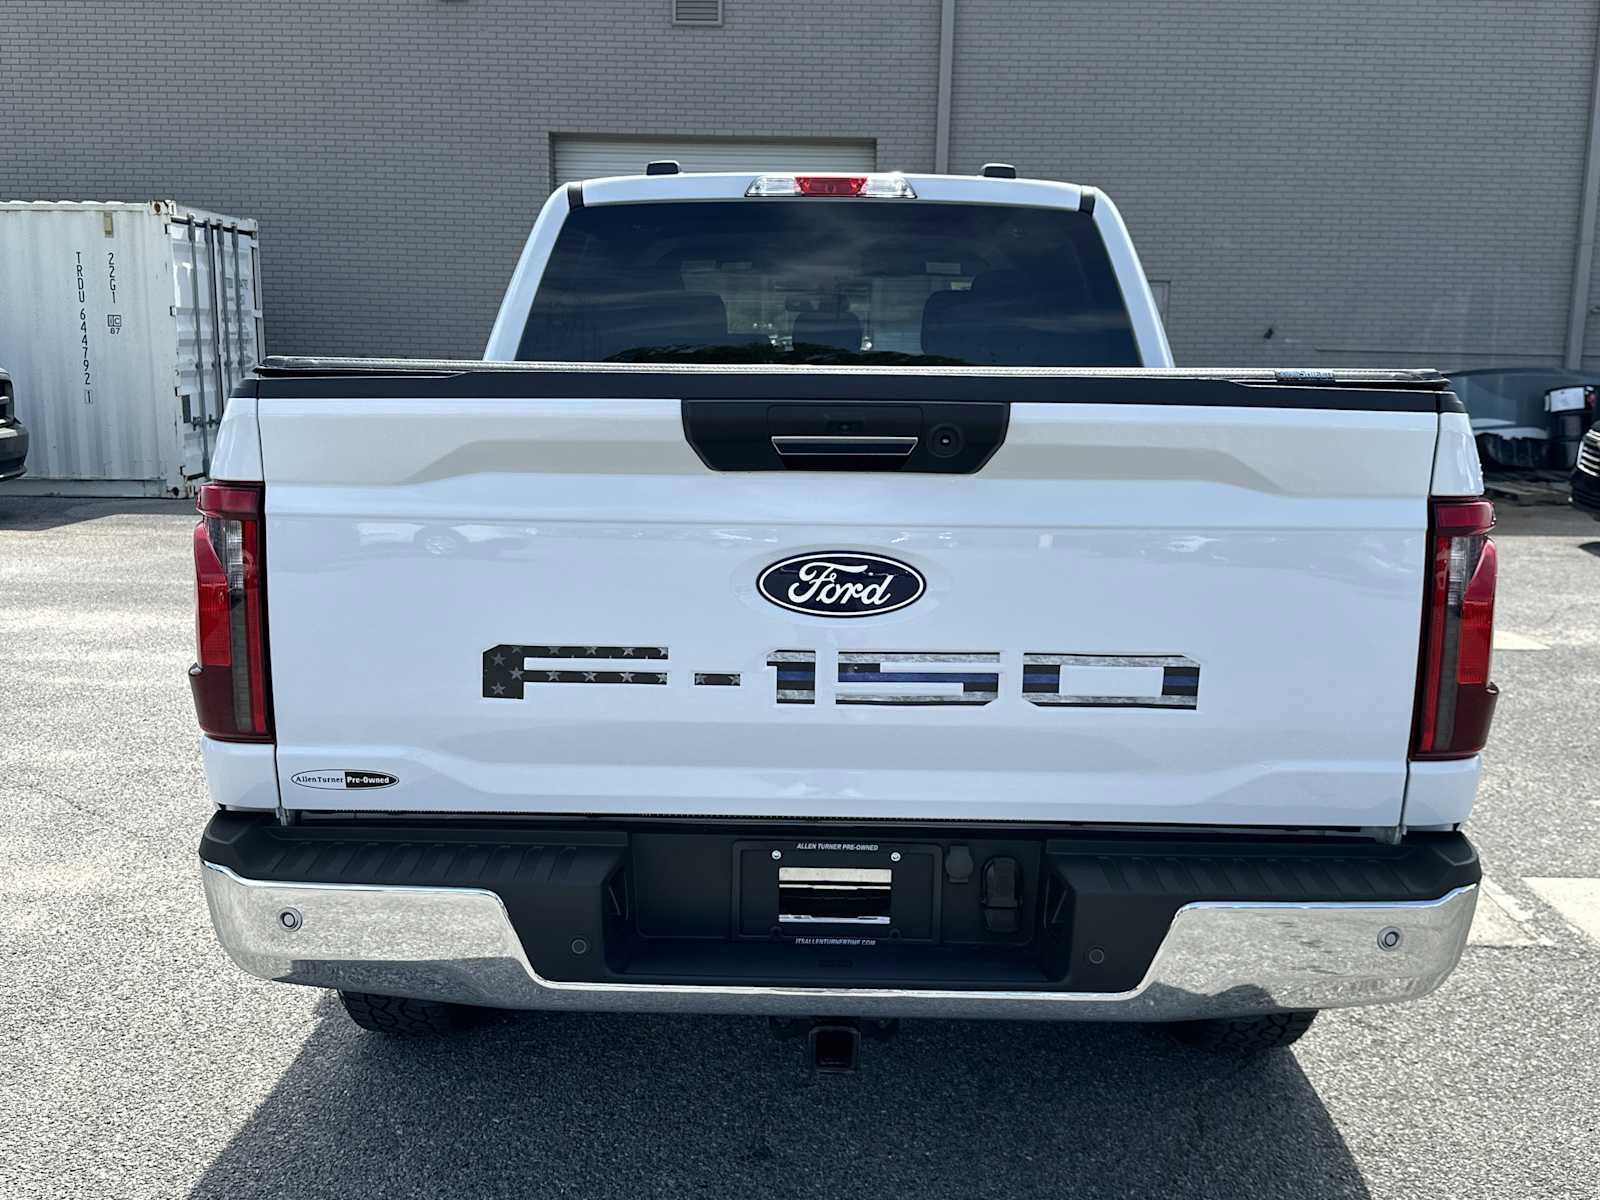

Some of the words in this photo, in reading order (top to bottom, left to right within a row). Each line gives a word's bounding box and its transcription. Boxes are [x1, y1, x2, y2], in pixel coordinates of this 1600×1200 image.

[76, 251, 85, 303] TRDU
[107, 252, 116, 304] 22G1
[80, 308, 91, 385] 644792
[787, 561, 895, 605] Ford
[482, 644, 1201, 711] F-150
[346, 776, 390, 784] Pre-Owned
[796, 842, 817, 850] ALLEN
[817, 843, 841, 851] TURNER
